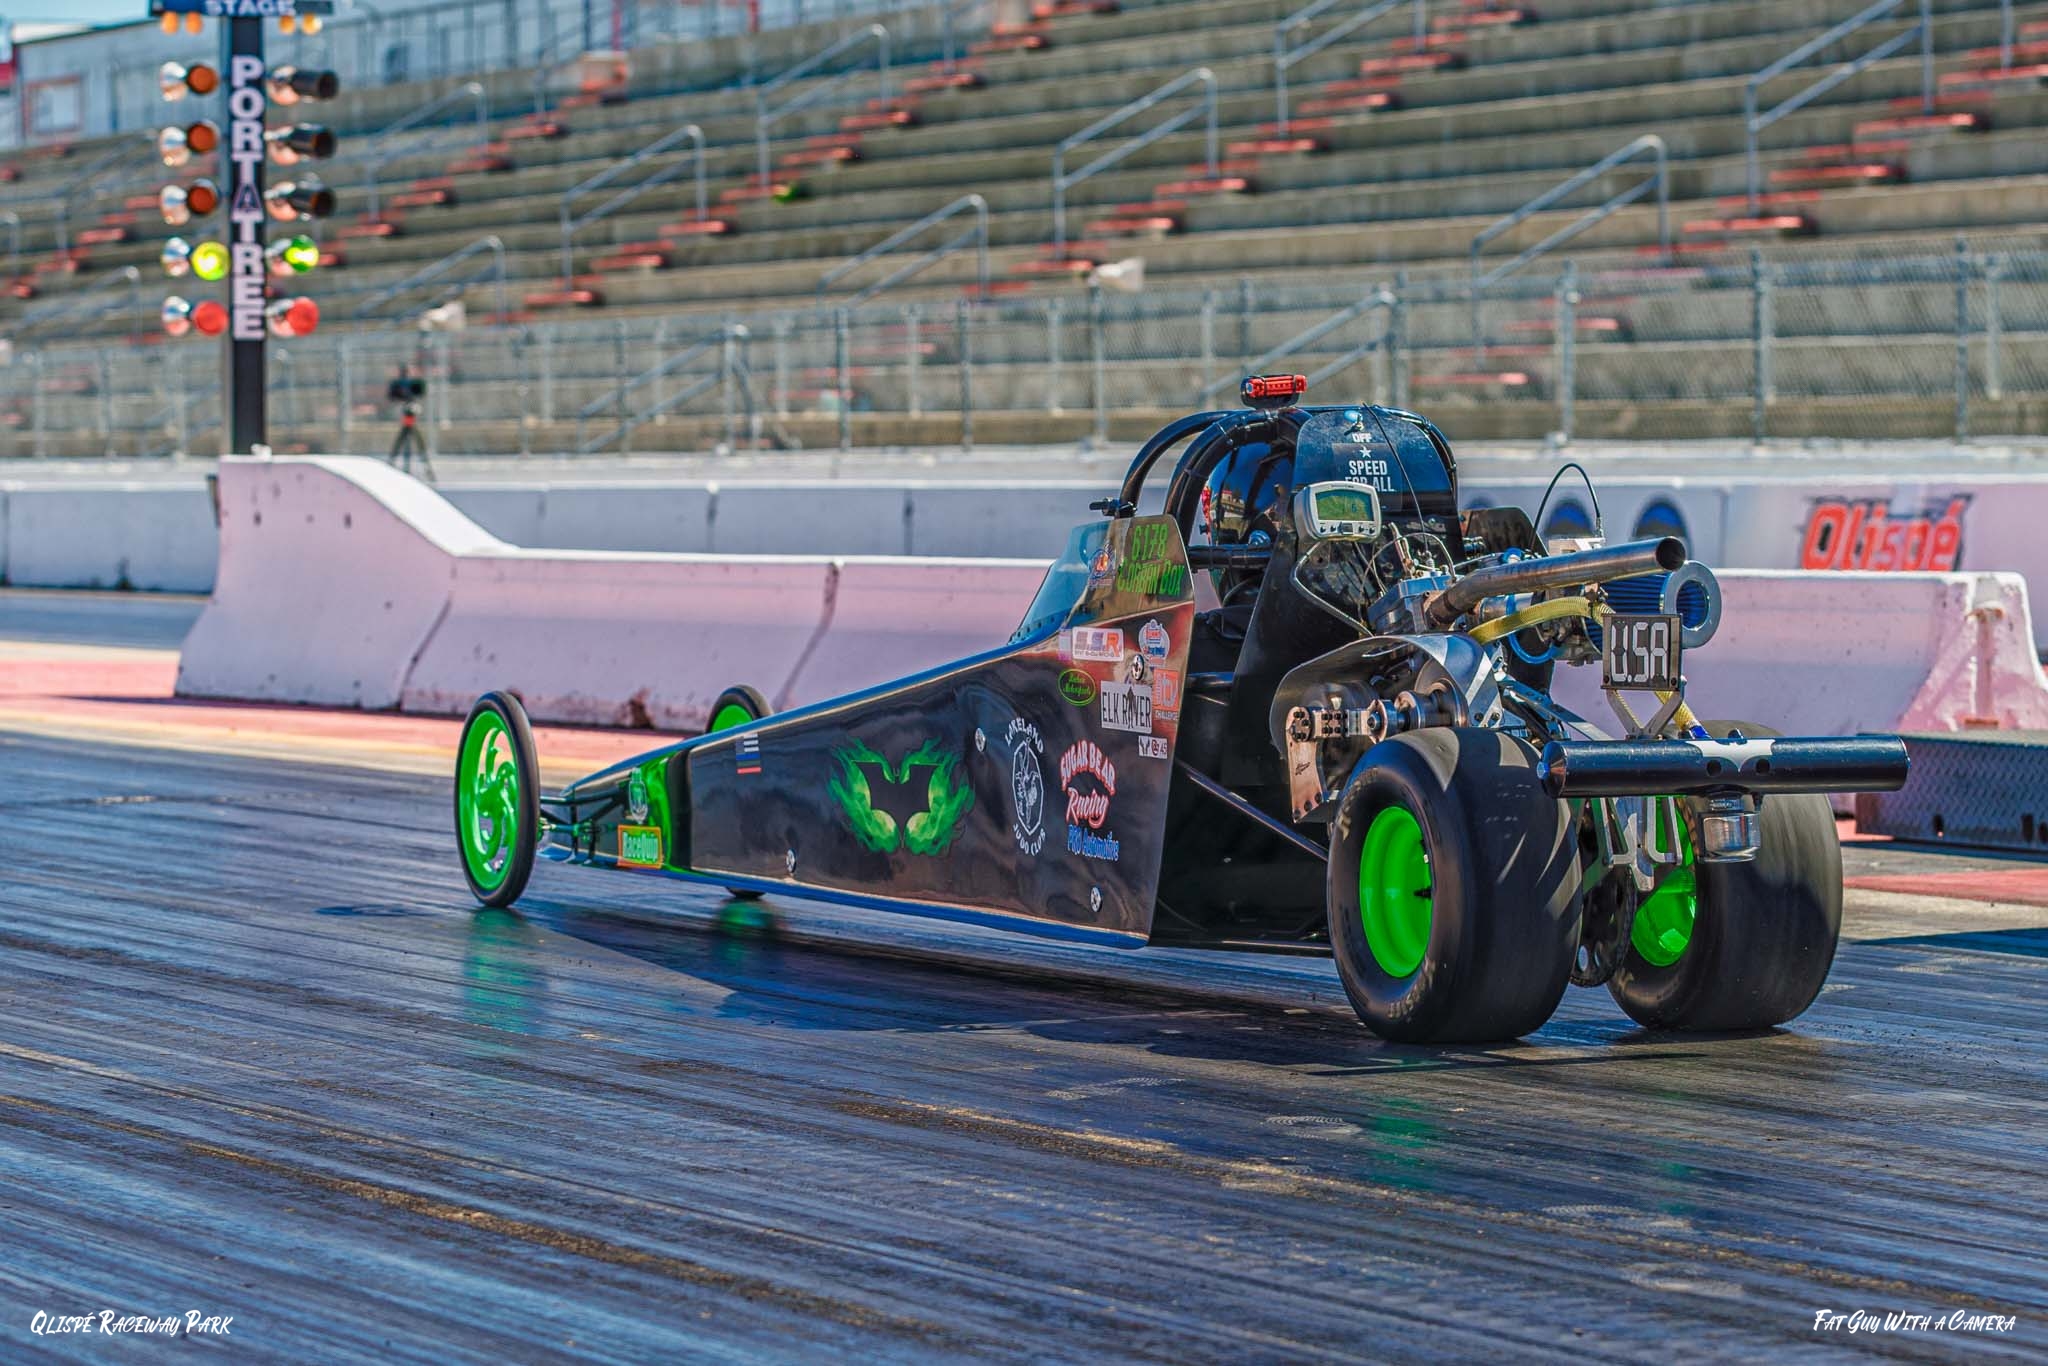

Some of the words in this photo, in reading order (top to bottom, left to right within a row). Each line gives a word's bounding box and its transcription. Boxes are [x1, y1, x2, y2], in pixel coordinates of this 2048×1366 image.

[205, 0, 296, 16] STAGE
[1352, 432, 1373, 443] OFF
[1349, 460, 1388, 476] SPEED
[1373, 476, 1395, 492] ALL
[1132, 523, 1169, 561] 6178
[1102, 692, 1120, 725] ELK
[1005, 717, 1044, 754] LAKELAND
[1060, 740, 1088, 791] SUGAR
[1089, 741, 1116, 796] BEAR
[1066, 787, 1110, 829] Racing
[1012, 823, 1029, 855] JUDO
